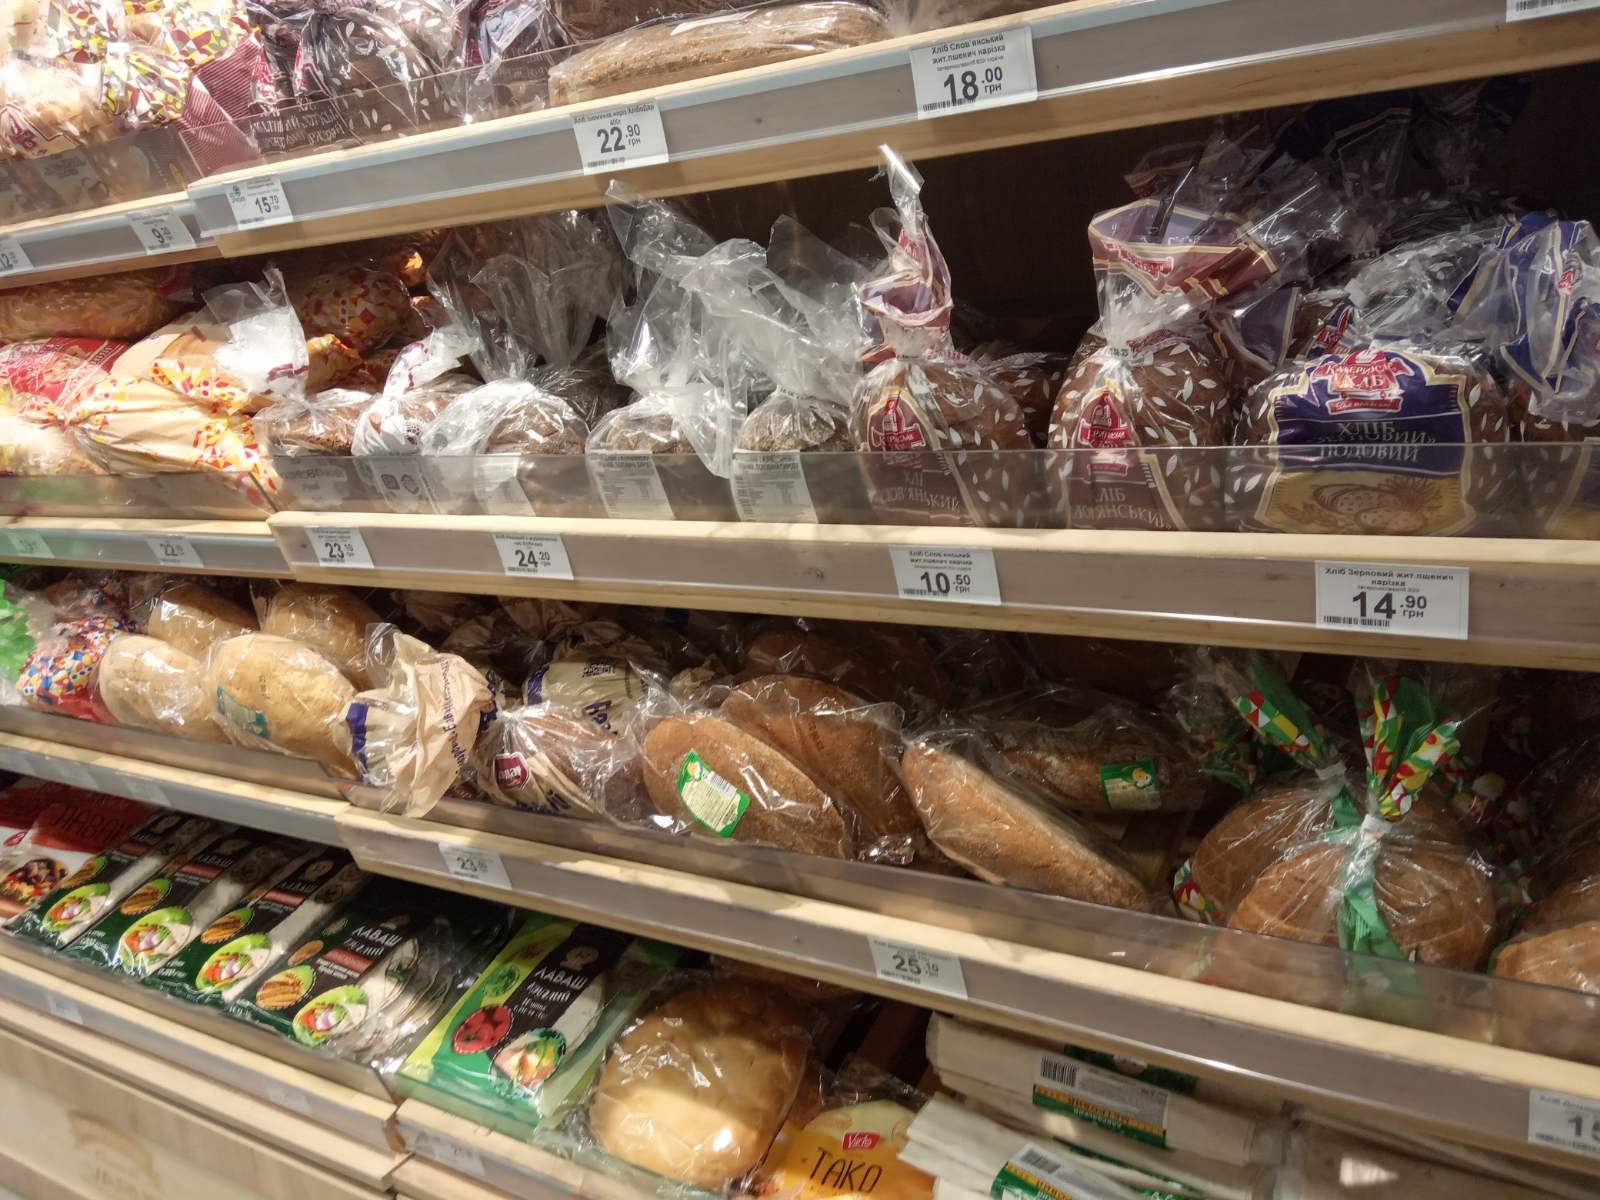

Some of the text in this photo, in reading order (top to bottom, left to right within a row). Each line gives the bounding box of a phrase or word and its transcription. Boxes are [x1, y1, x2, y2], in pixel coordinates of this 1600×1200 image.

[931, 45, 949, 55] Хліб
[978, 44, 1006, 56] нарізка
[944, 70, 979, 104] 18
[984, 82, 1002, 95] грн
[596, 126, 626, 154] 22
[255, 196, 272, 214] 15
[324, 542, 344, 559] 23
[514, 549, 539, 568] 24
[1324, 567, 1346, 576] Хліб
[920, 571, 951, 594] 10
[955, 584, 970, 593] грн
[1352, 591, 1396, 620] 14
[1402, 608, 1424, 619] грн
[351, 925, 403, 947] ЛАВАШ
[892, 954, 922, 975] 25
[534, 966, 589, 990] ЛАВАШ
[810, 1146, 883, 1194] ТАКО
